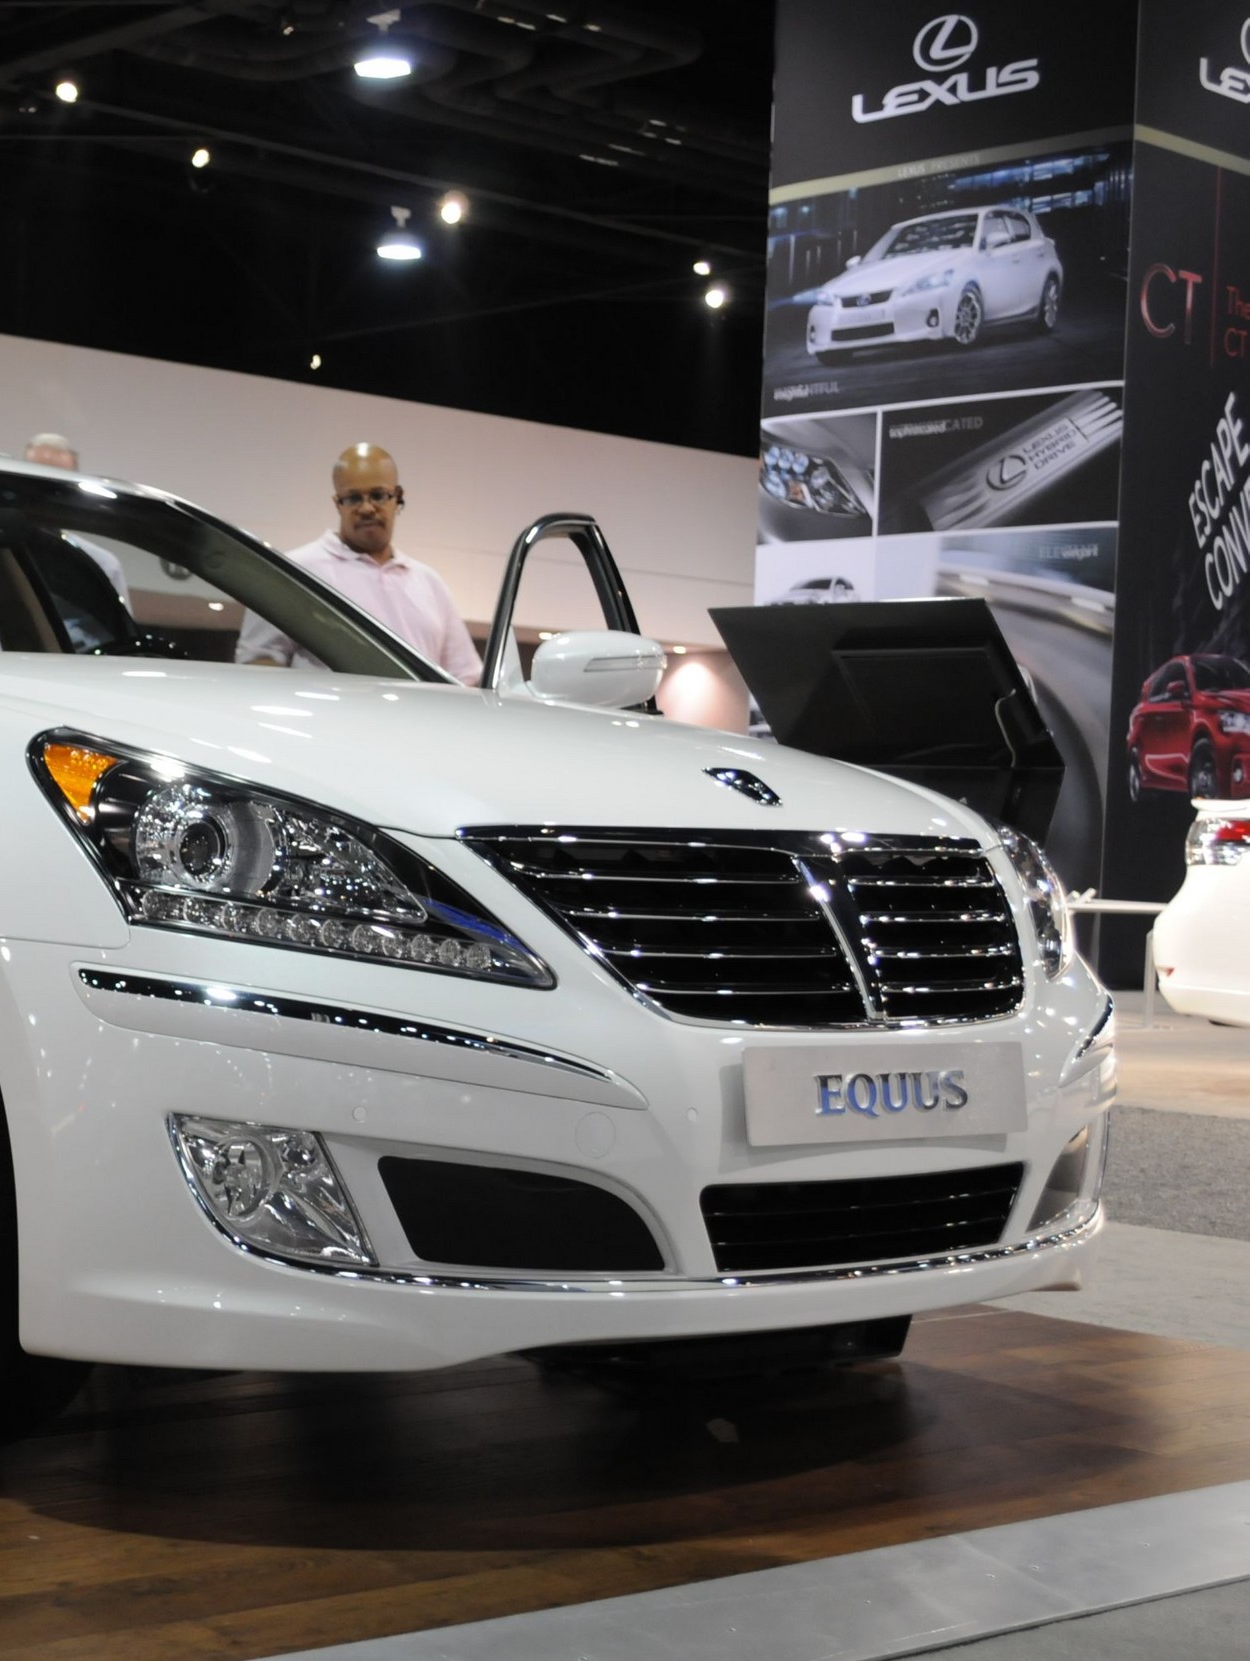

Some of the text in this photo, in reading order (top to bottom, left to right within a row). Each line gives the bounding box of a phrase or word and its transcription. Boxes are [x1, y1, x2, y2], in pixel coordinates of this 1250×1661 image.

[852, 59, 1040, 124] LEXUS
[1140, 263, 1202, 345] CT
[1034, 442, 1075, 470] DRIVE
[1189, 391, 1250, 549] ESCAPE
[814, 1069, 969, 1117] EQUUS
